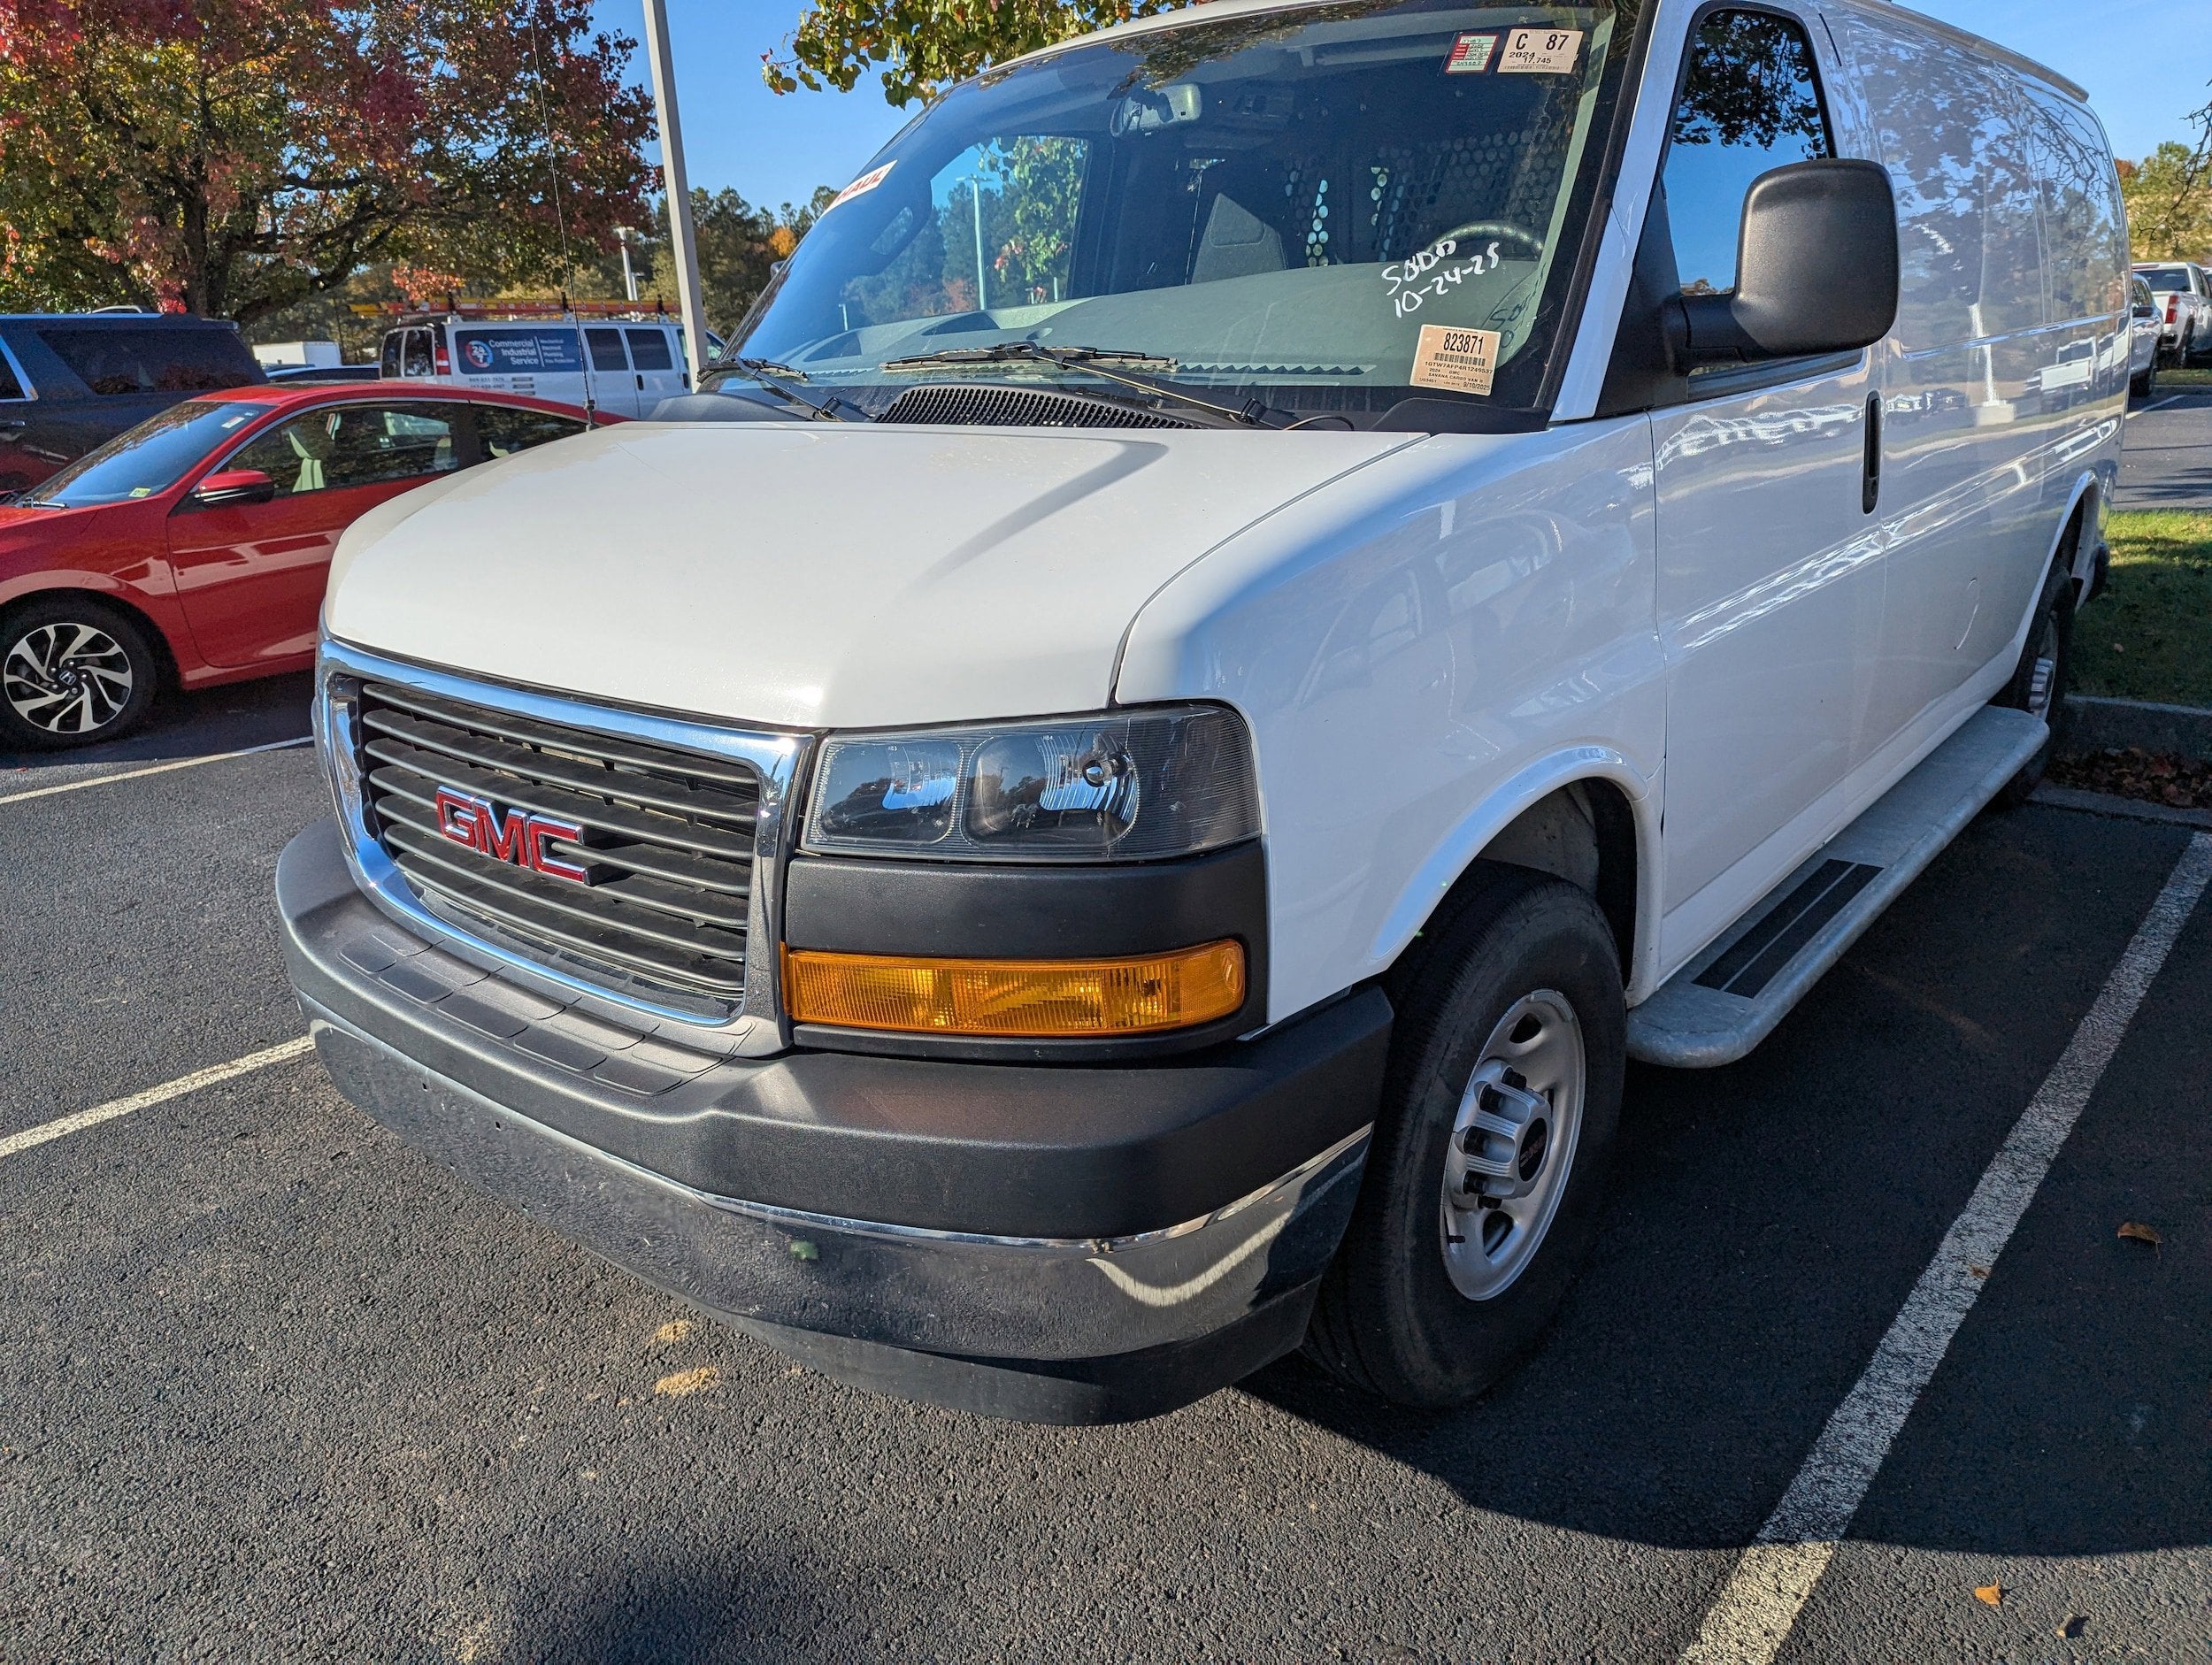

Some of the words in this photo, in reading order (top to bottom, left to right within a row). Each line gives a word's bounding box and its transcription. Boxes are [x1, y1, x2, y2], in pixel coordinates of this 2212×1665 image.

[1516, 33, 1528, 50] C
[1546, 34, 1570, 50] 87
[488, 339, 534, 348] Commercial
[1443, 332, 1484, 355] 823871
[501, 348, 537, 357] Industrial
[510, 357, 539, 365] Service
[436, 785, 590, 886] GMC
